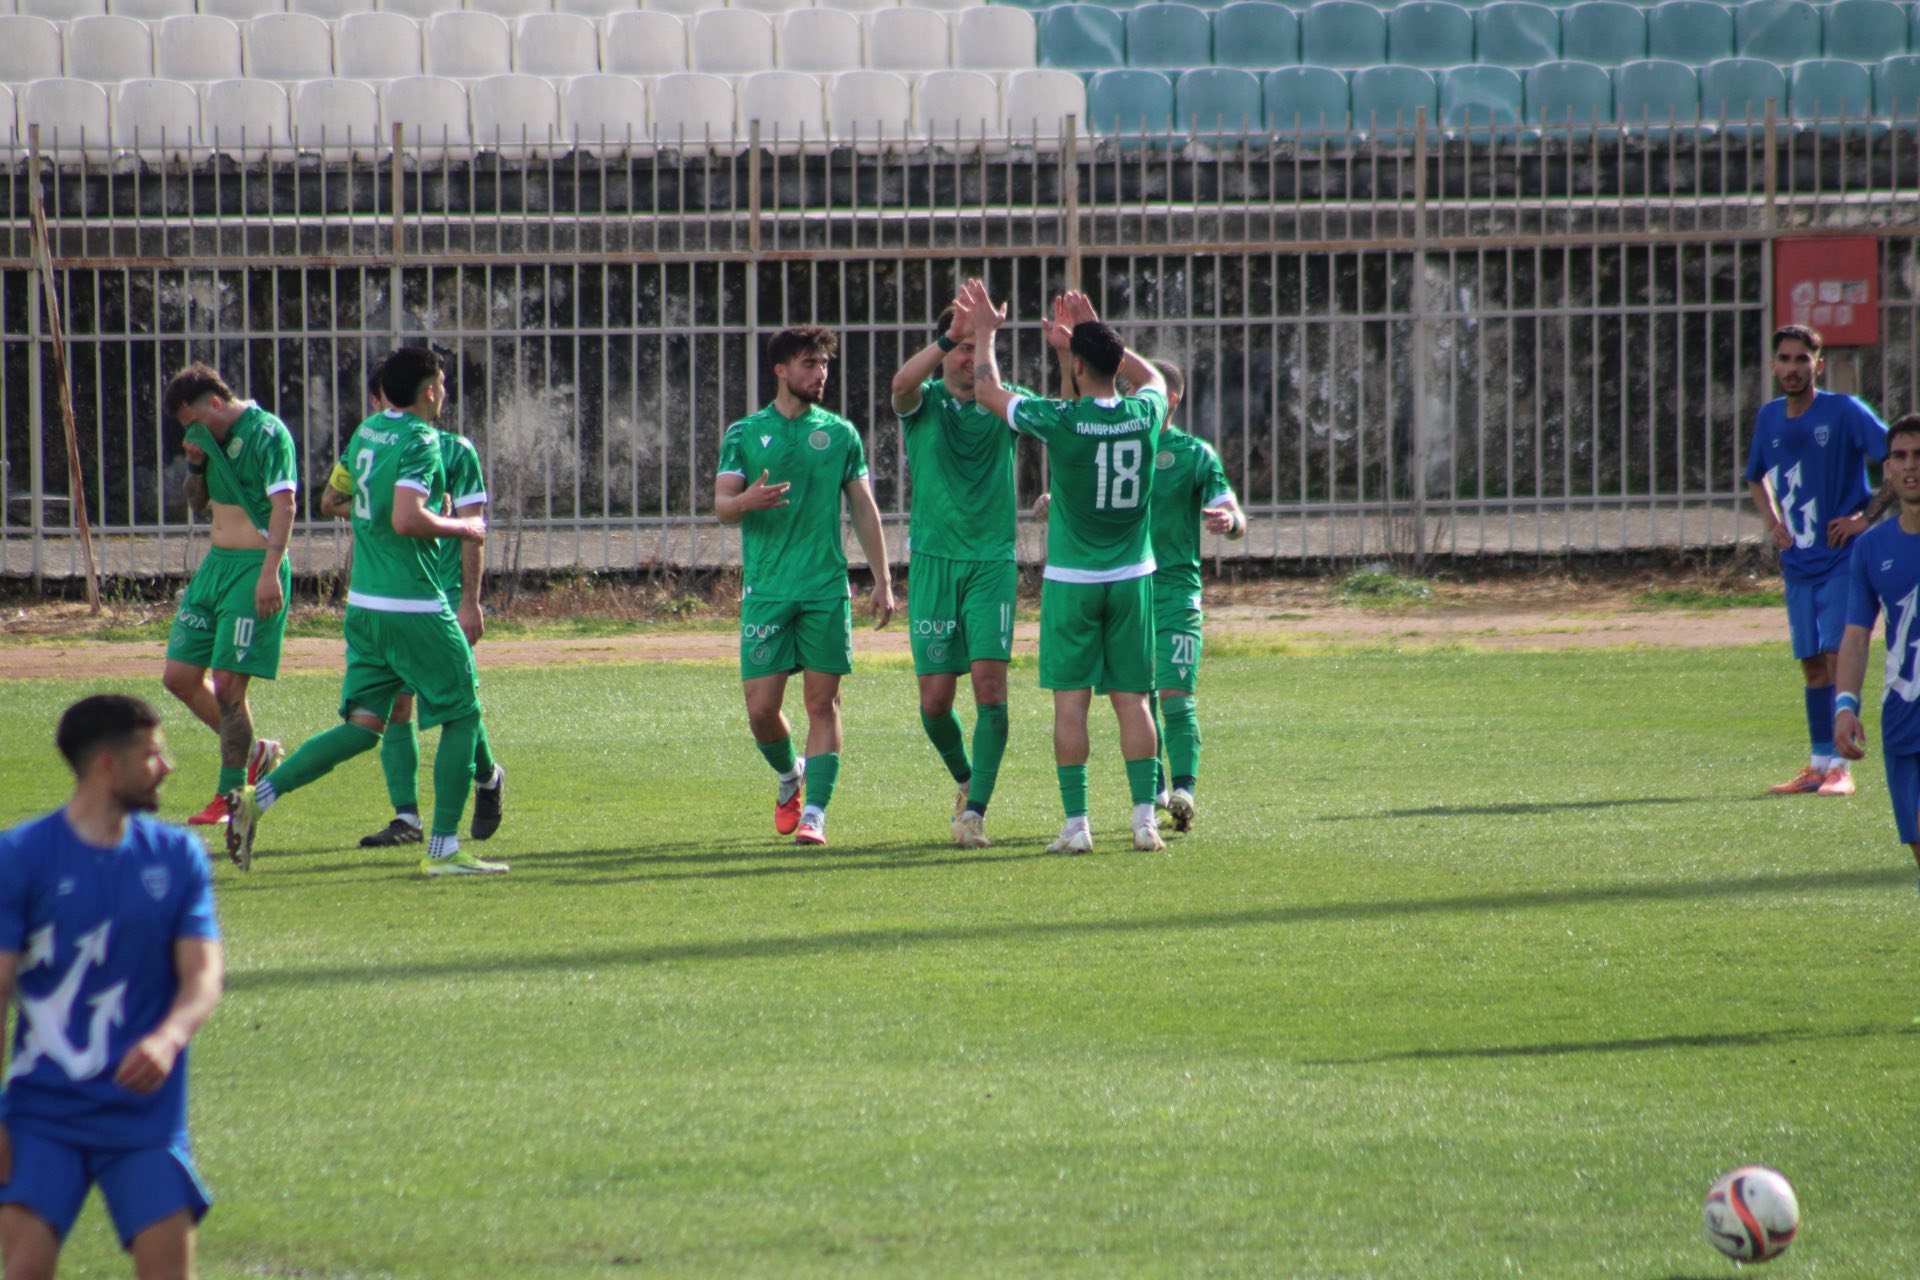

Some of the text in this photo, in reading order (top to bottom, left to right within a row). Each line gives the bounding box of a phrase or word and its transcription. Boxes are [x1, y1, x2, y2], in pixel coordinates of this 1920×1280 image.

[355, 449, 374, 519] 3
[1095, 440, 1142, 508] 18
[233, 616, 255, 648] 10
[1000, 603, 1010, 633] 11
[1171, 634, 1195, 665] 20
